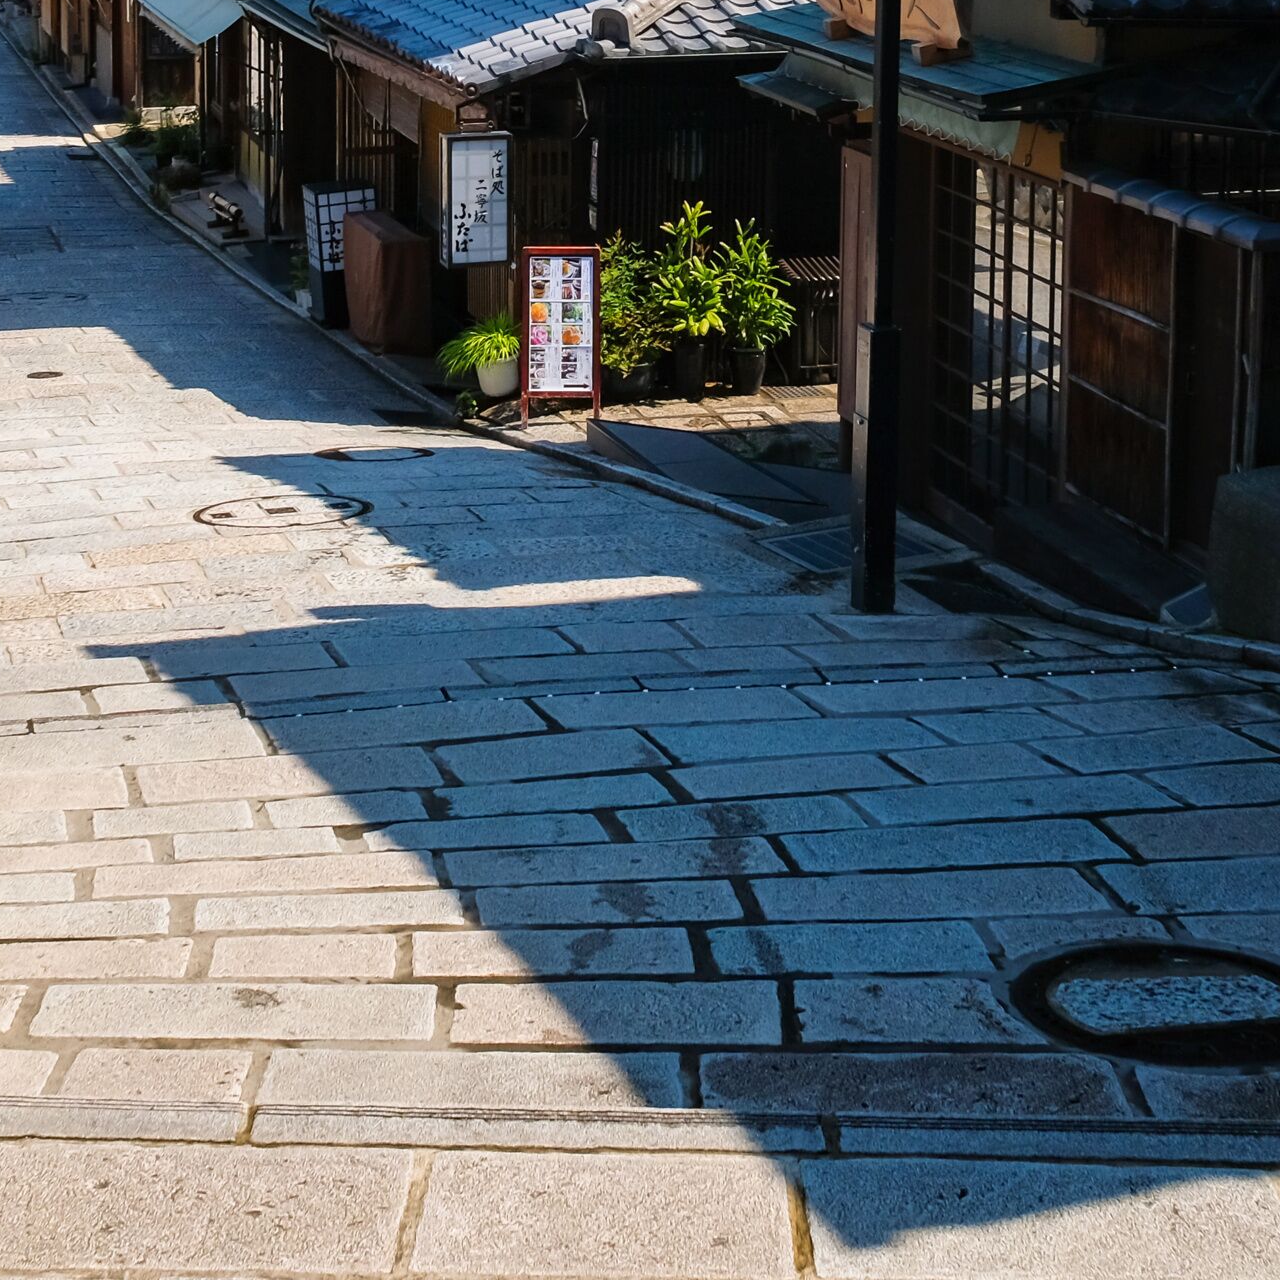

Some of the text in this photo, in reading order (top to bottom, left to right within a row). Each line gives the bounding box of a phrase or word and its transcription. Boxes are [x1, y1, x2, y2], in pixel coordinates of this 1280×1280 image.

[490, 149, 505, 195] そば処
[473, 179, 489, 224] 二寧坂
[454, 202, 474, 252] ふたば
